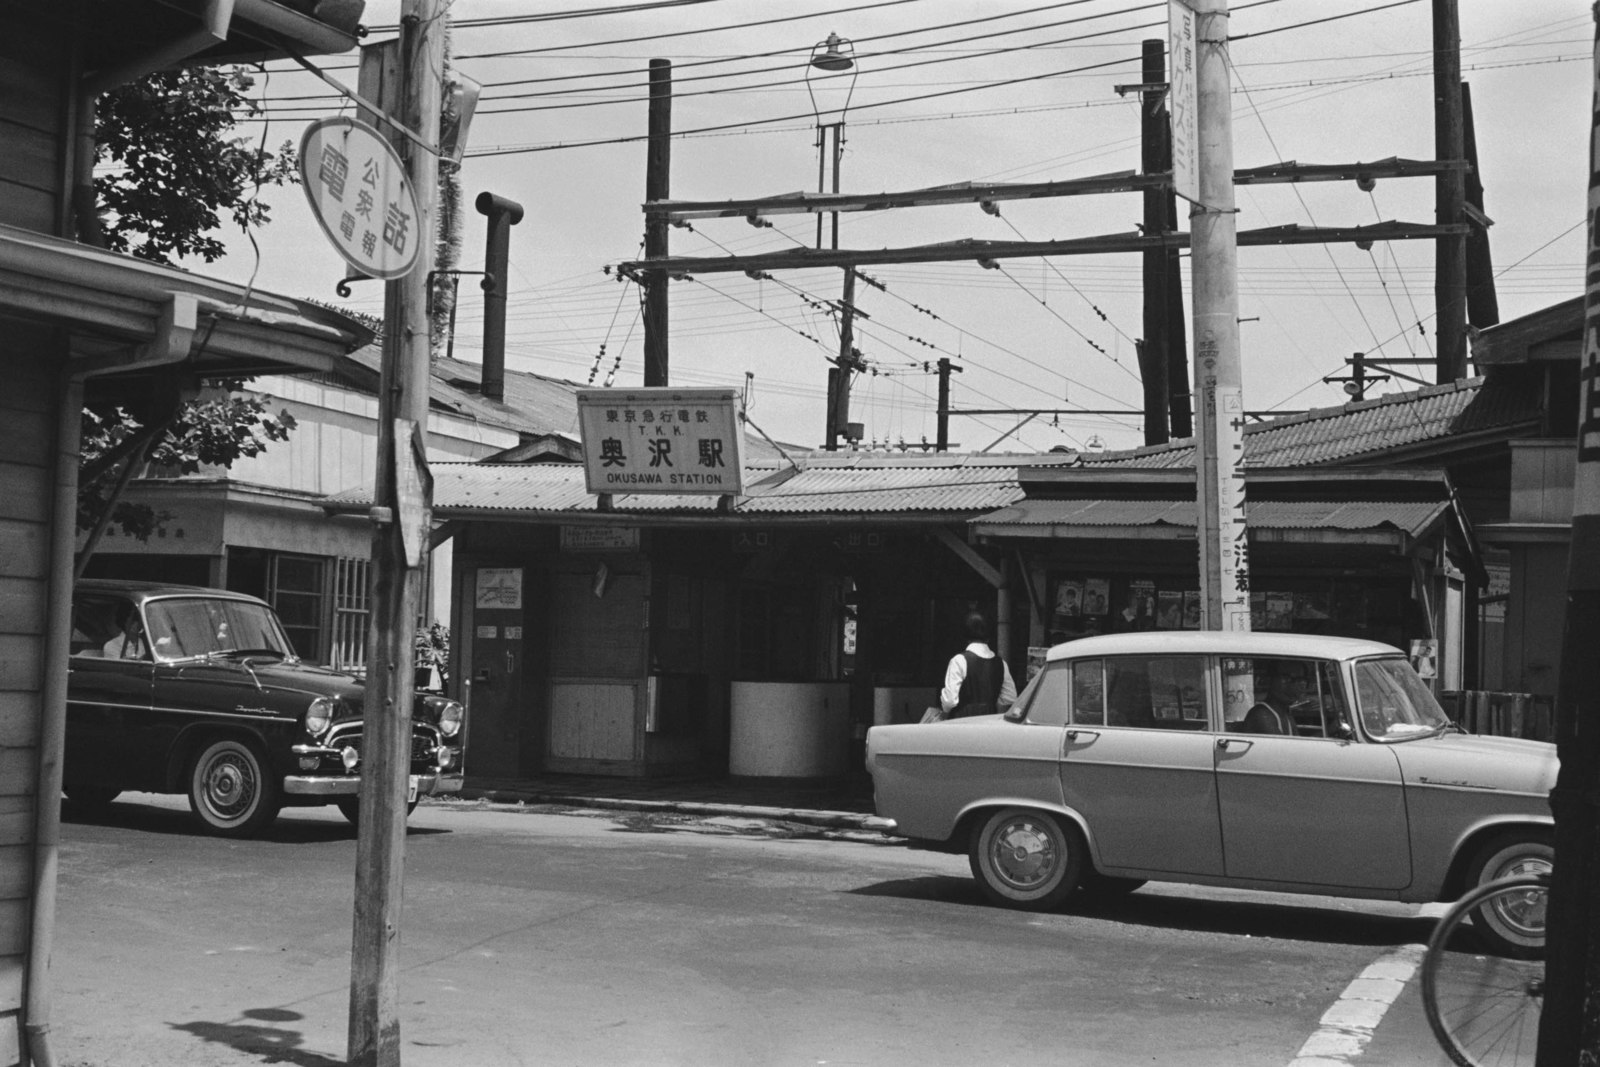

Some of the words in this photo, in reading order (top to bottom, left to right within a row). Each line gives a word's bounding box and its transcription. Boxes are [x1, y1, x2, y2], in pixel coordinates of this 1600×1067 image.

[606, 409, 709, 423] 東京急行電鉄
[599, 437, 725, 468] 奥沢駅
[607, 473, 663, 484] OKUSAWA
[670, 473, 722, 485] STATION
[738, 532, 768, 545] 入口
[848, 532, 880, 545] 出口
